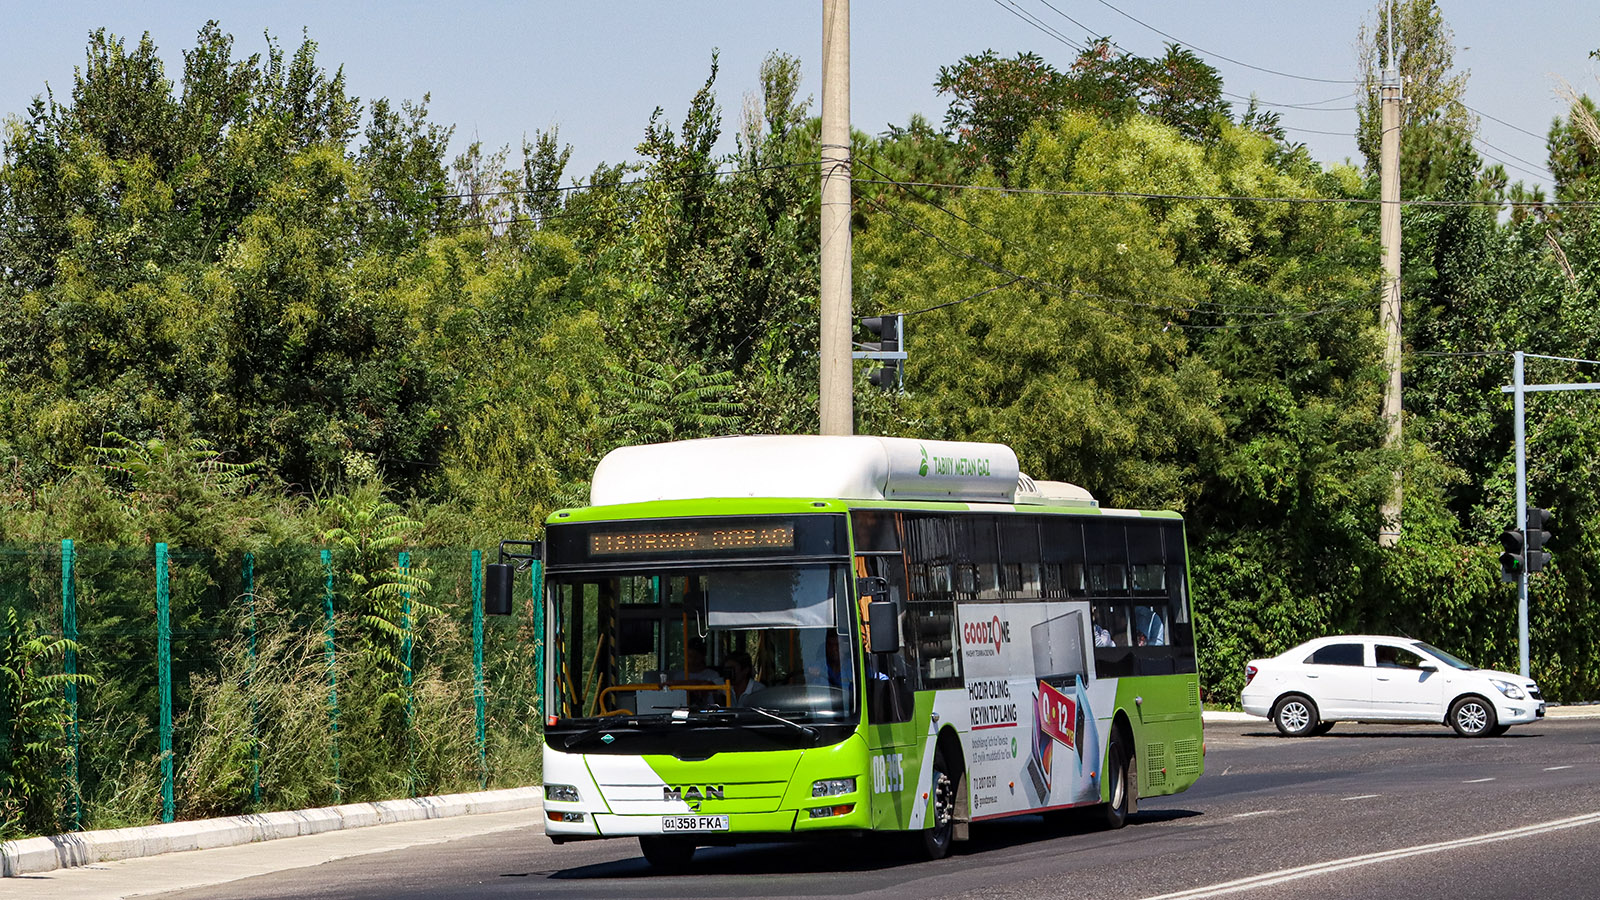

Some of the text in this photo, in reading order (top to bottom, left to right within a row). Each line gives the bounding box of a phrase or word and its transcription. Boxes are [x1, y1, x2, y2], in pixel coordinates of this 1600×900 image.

[955, 458, 976, 476] METAN
[978, 458, 990, 476] GAZ
[968, 680, 1010, 700] HOZIR OLING,
[970, 706, 989, 725] KEYIN
[1057, 701, 1069, 735] 12
[663, 784, 724, 801] MAN
[664, 817, 722, 829] 01 358 FKA
